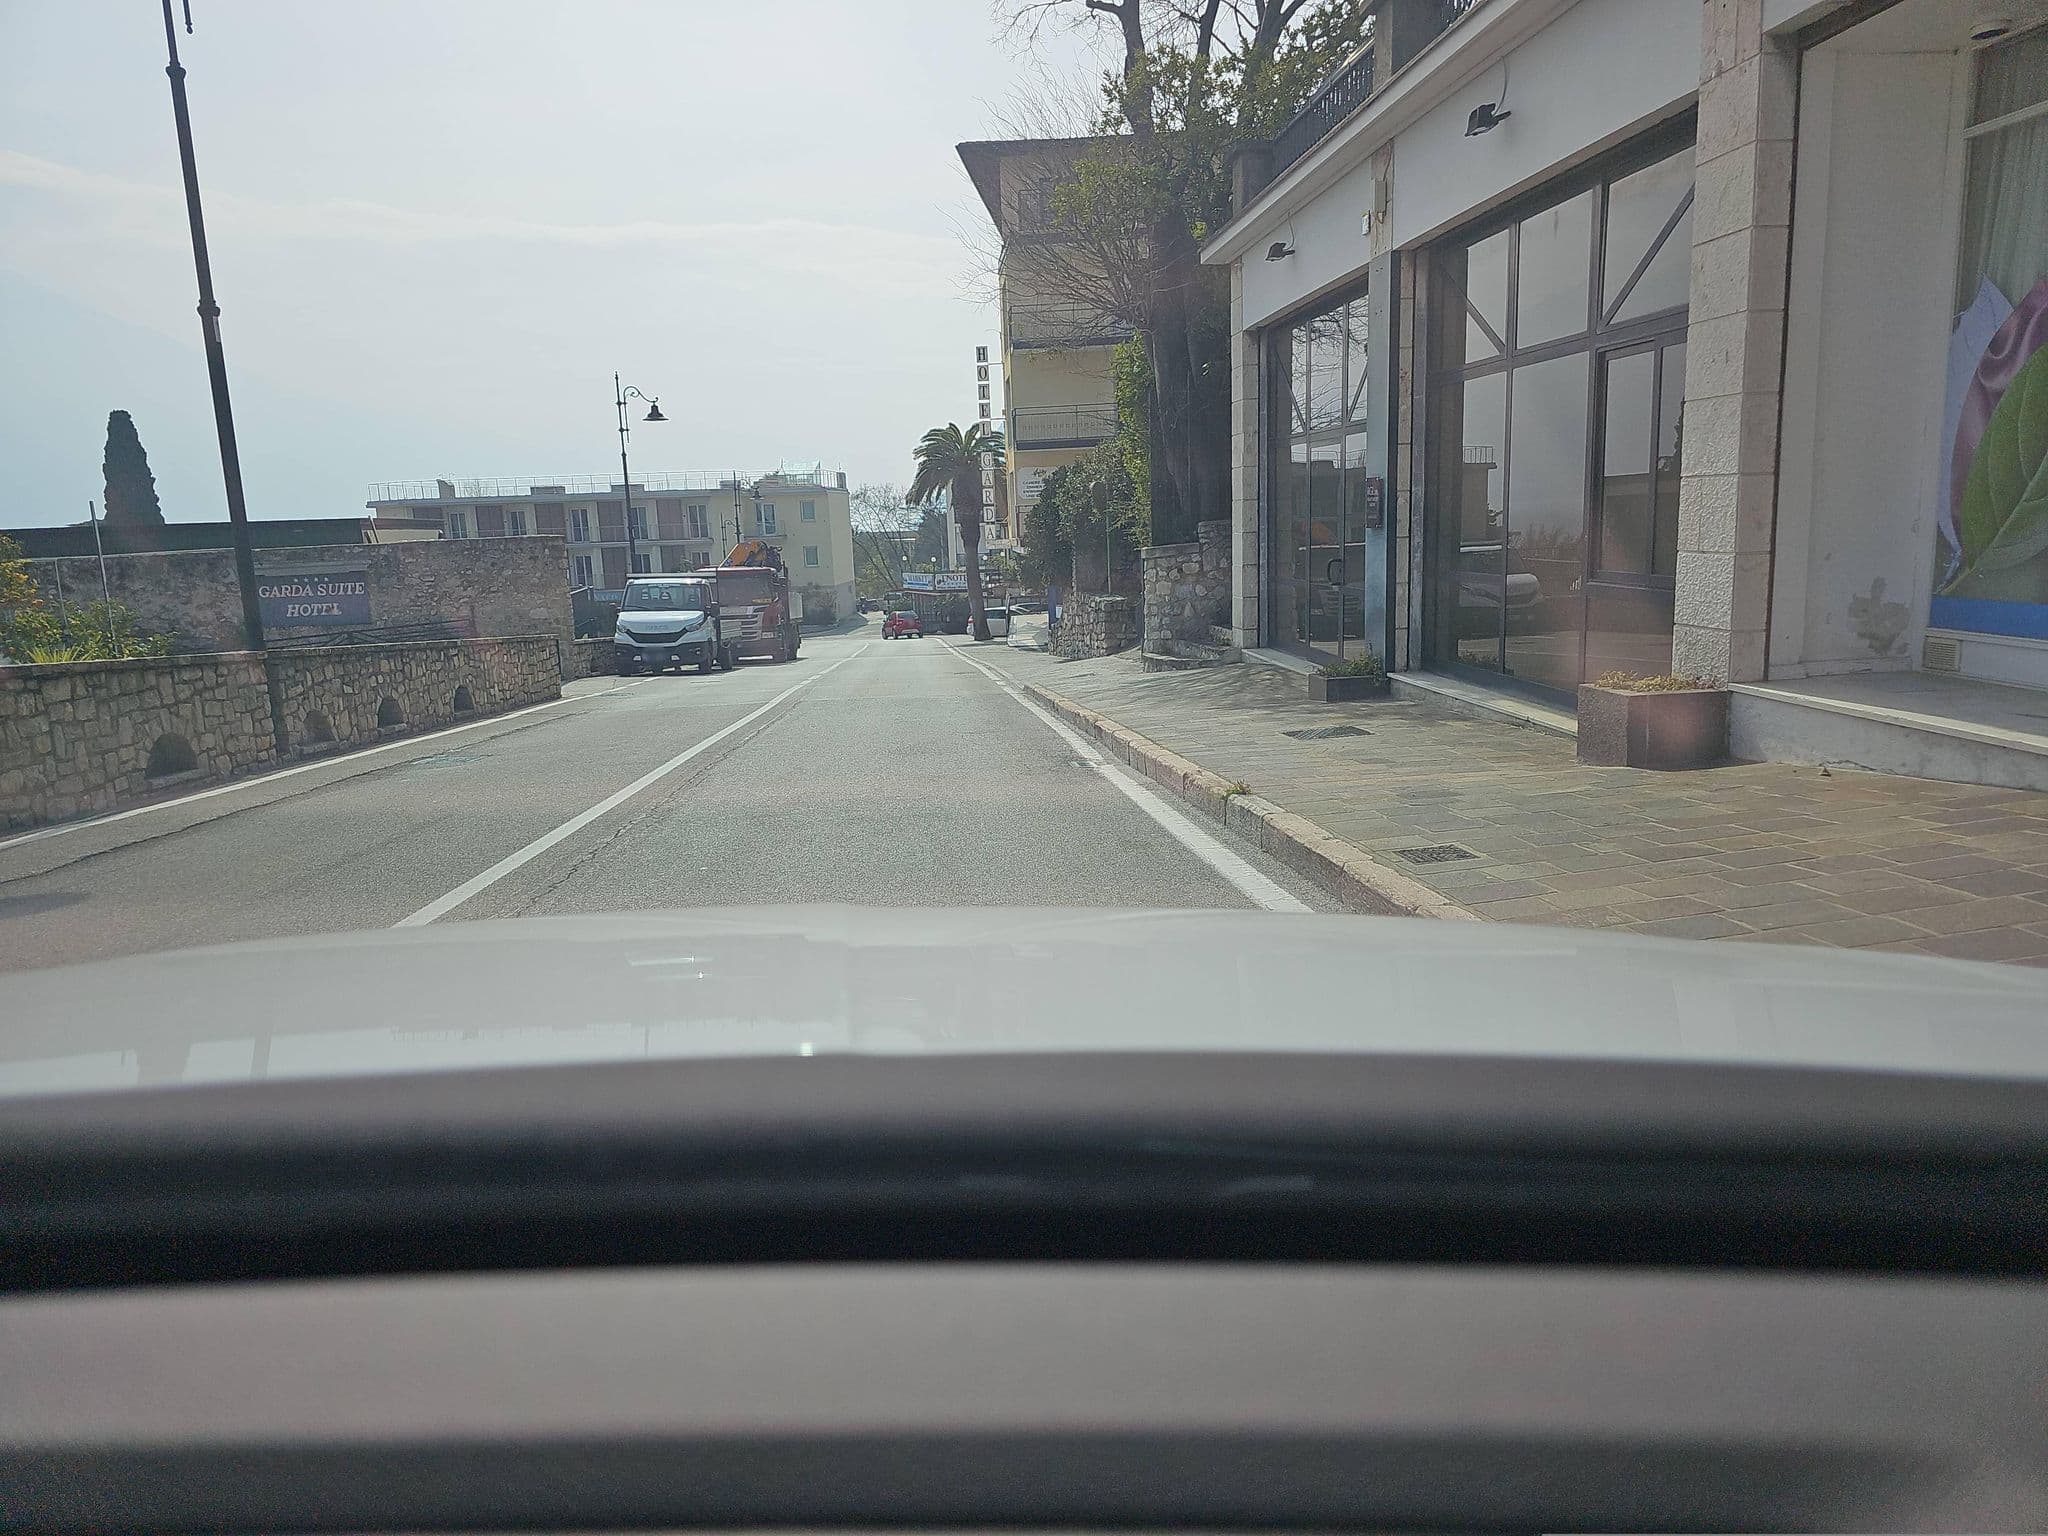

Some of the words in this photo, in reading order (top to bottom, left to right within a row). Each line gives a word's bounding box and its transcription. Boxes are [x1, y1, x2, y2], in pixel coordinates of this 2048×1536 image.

[977, 347, 990, 436] HOTEL
[982, 453, 995, 539] GARDA
[258, 584, 314, 598] GARDA
[317, 582, 365, 596] SUITE
[286, 602, 342, 617] HOTEL
